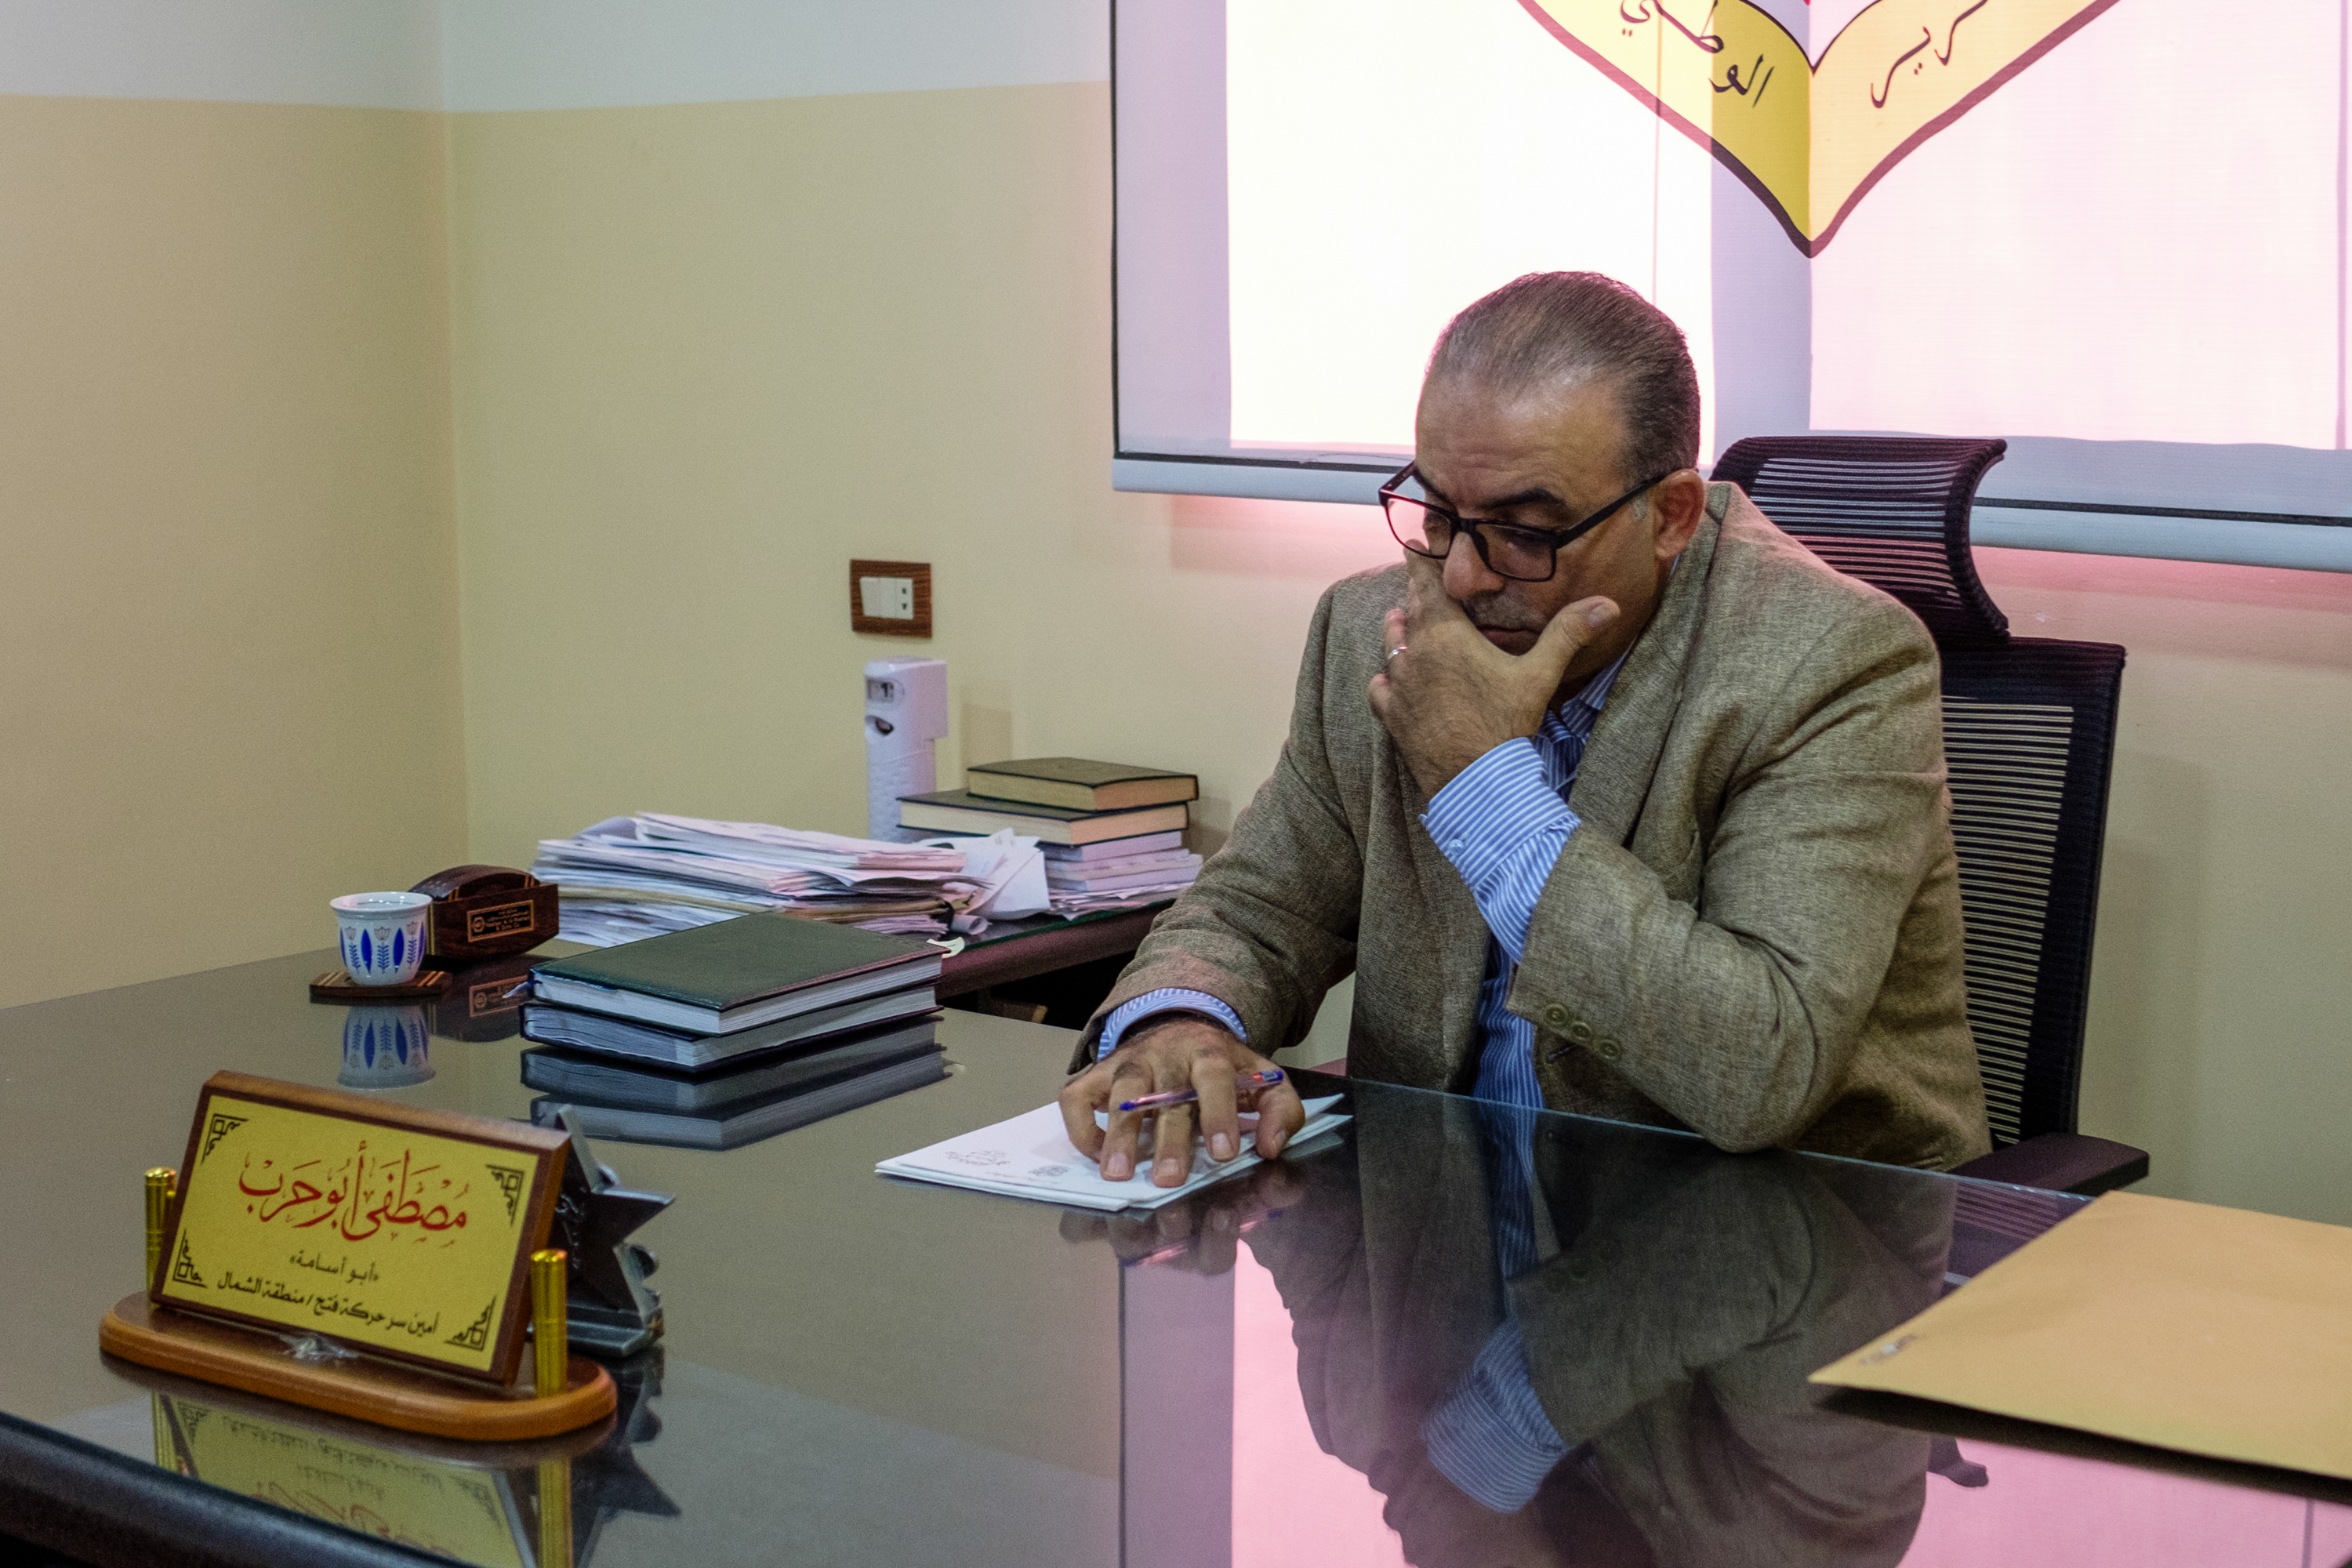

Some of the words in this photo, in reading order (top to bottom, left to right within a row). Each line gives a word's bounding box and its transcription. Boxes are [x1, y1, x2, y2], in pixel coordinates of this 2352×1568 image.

[216, 1271, 263, 1294] الشمال
[261, 1280, 305, 1304] منطقة
[313, 1294, 339, 1316] فتح
[339, 1298, 386, 1326] حركة
[384, 1317, 406, 1330] سر
